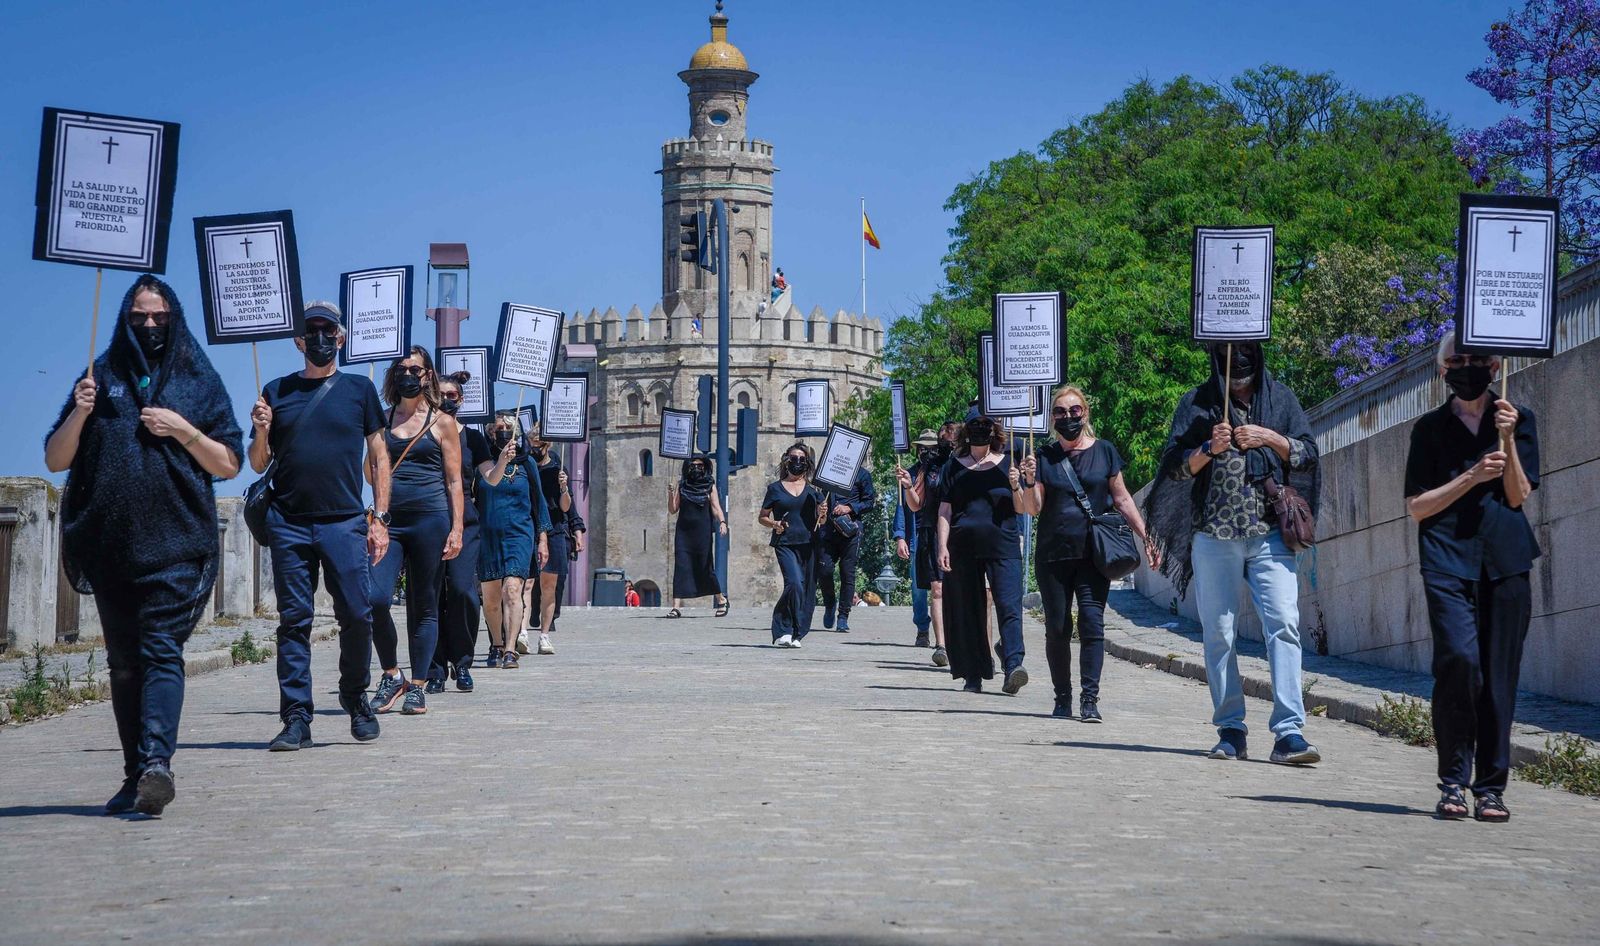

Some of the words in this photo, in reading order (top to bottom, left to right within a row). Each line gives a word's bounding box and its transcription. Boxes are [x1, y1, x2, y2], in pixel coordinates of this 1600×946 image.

[86, 183, 116, 192] SALUD
[64, 190, 86, 199] VIDA
[103, 194, 144, 205] NUESTRO
[87, 202, 125, 213] GRANDE
[82, 212, 124, 222] NUESTRA
[75, 221, 128, 233] PRIORIDAD.
[219, 262, 265, 270] DEPENDEMOS
[1498, 290, 1538, 298] ENTRARÁN
[356, 315, 394, 323] GUADALQUIVIR
